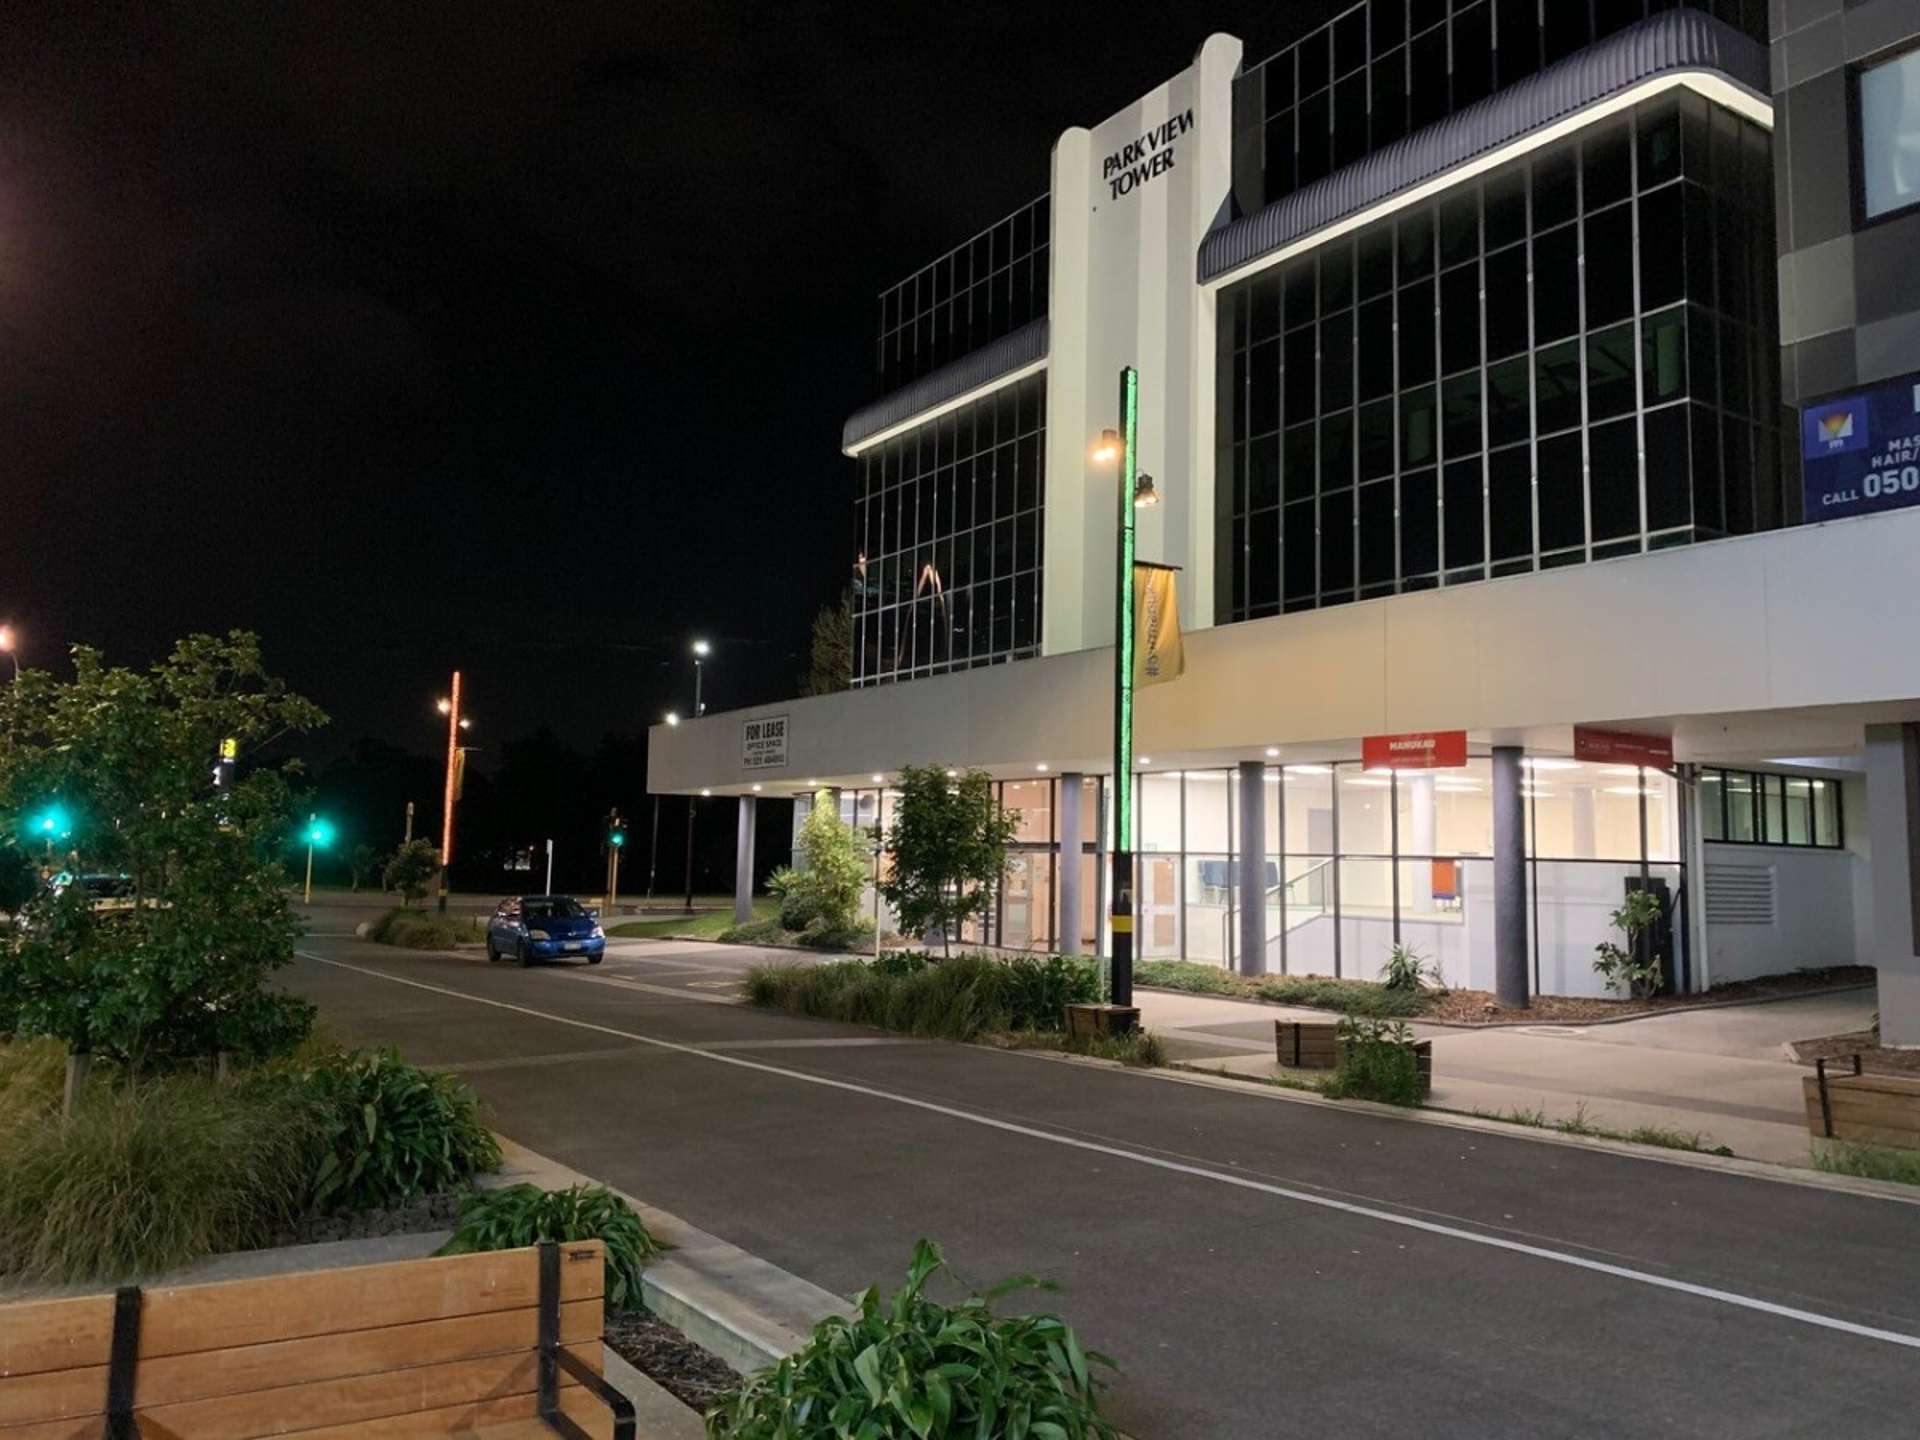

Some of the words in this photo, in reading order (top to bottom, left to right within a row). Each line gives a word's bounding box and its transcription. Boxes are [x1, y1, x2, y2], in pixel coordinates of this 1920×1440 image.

[1103, 135, 1146, 180] PARK
[1147, 107, 1194, 151] VIEW
[1109, 147, 1175, 201] TOWER
[1822, 489, 1859, 505] CALL
[746, 724, 761, 741] FOR
[762, 720, 785, 738] LEASE
